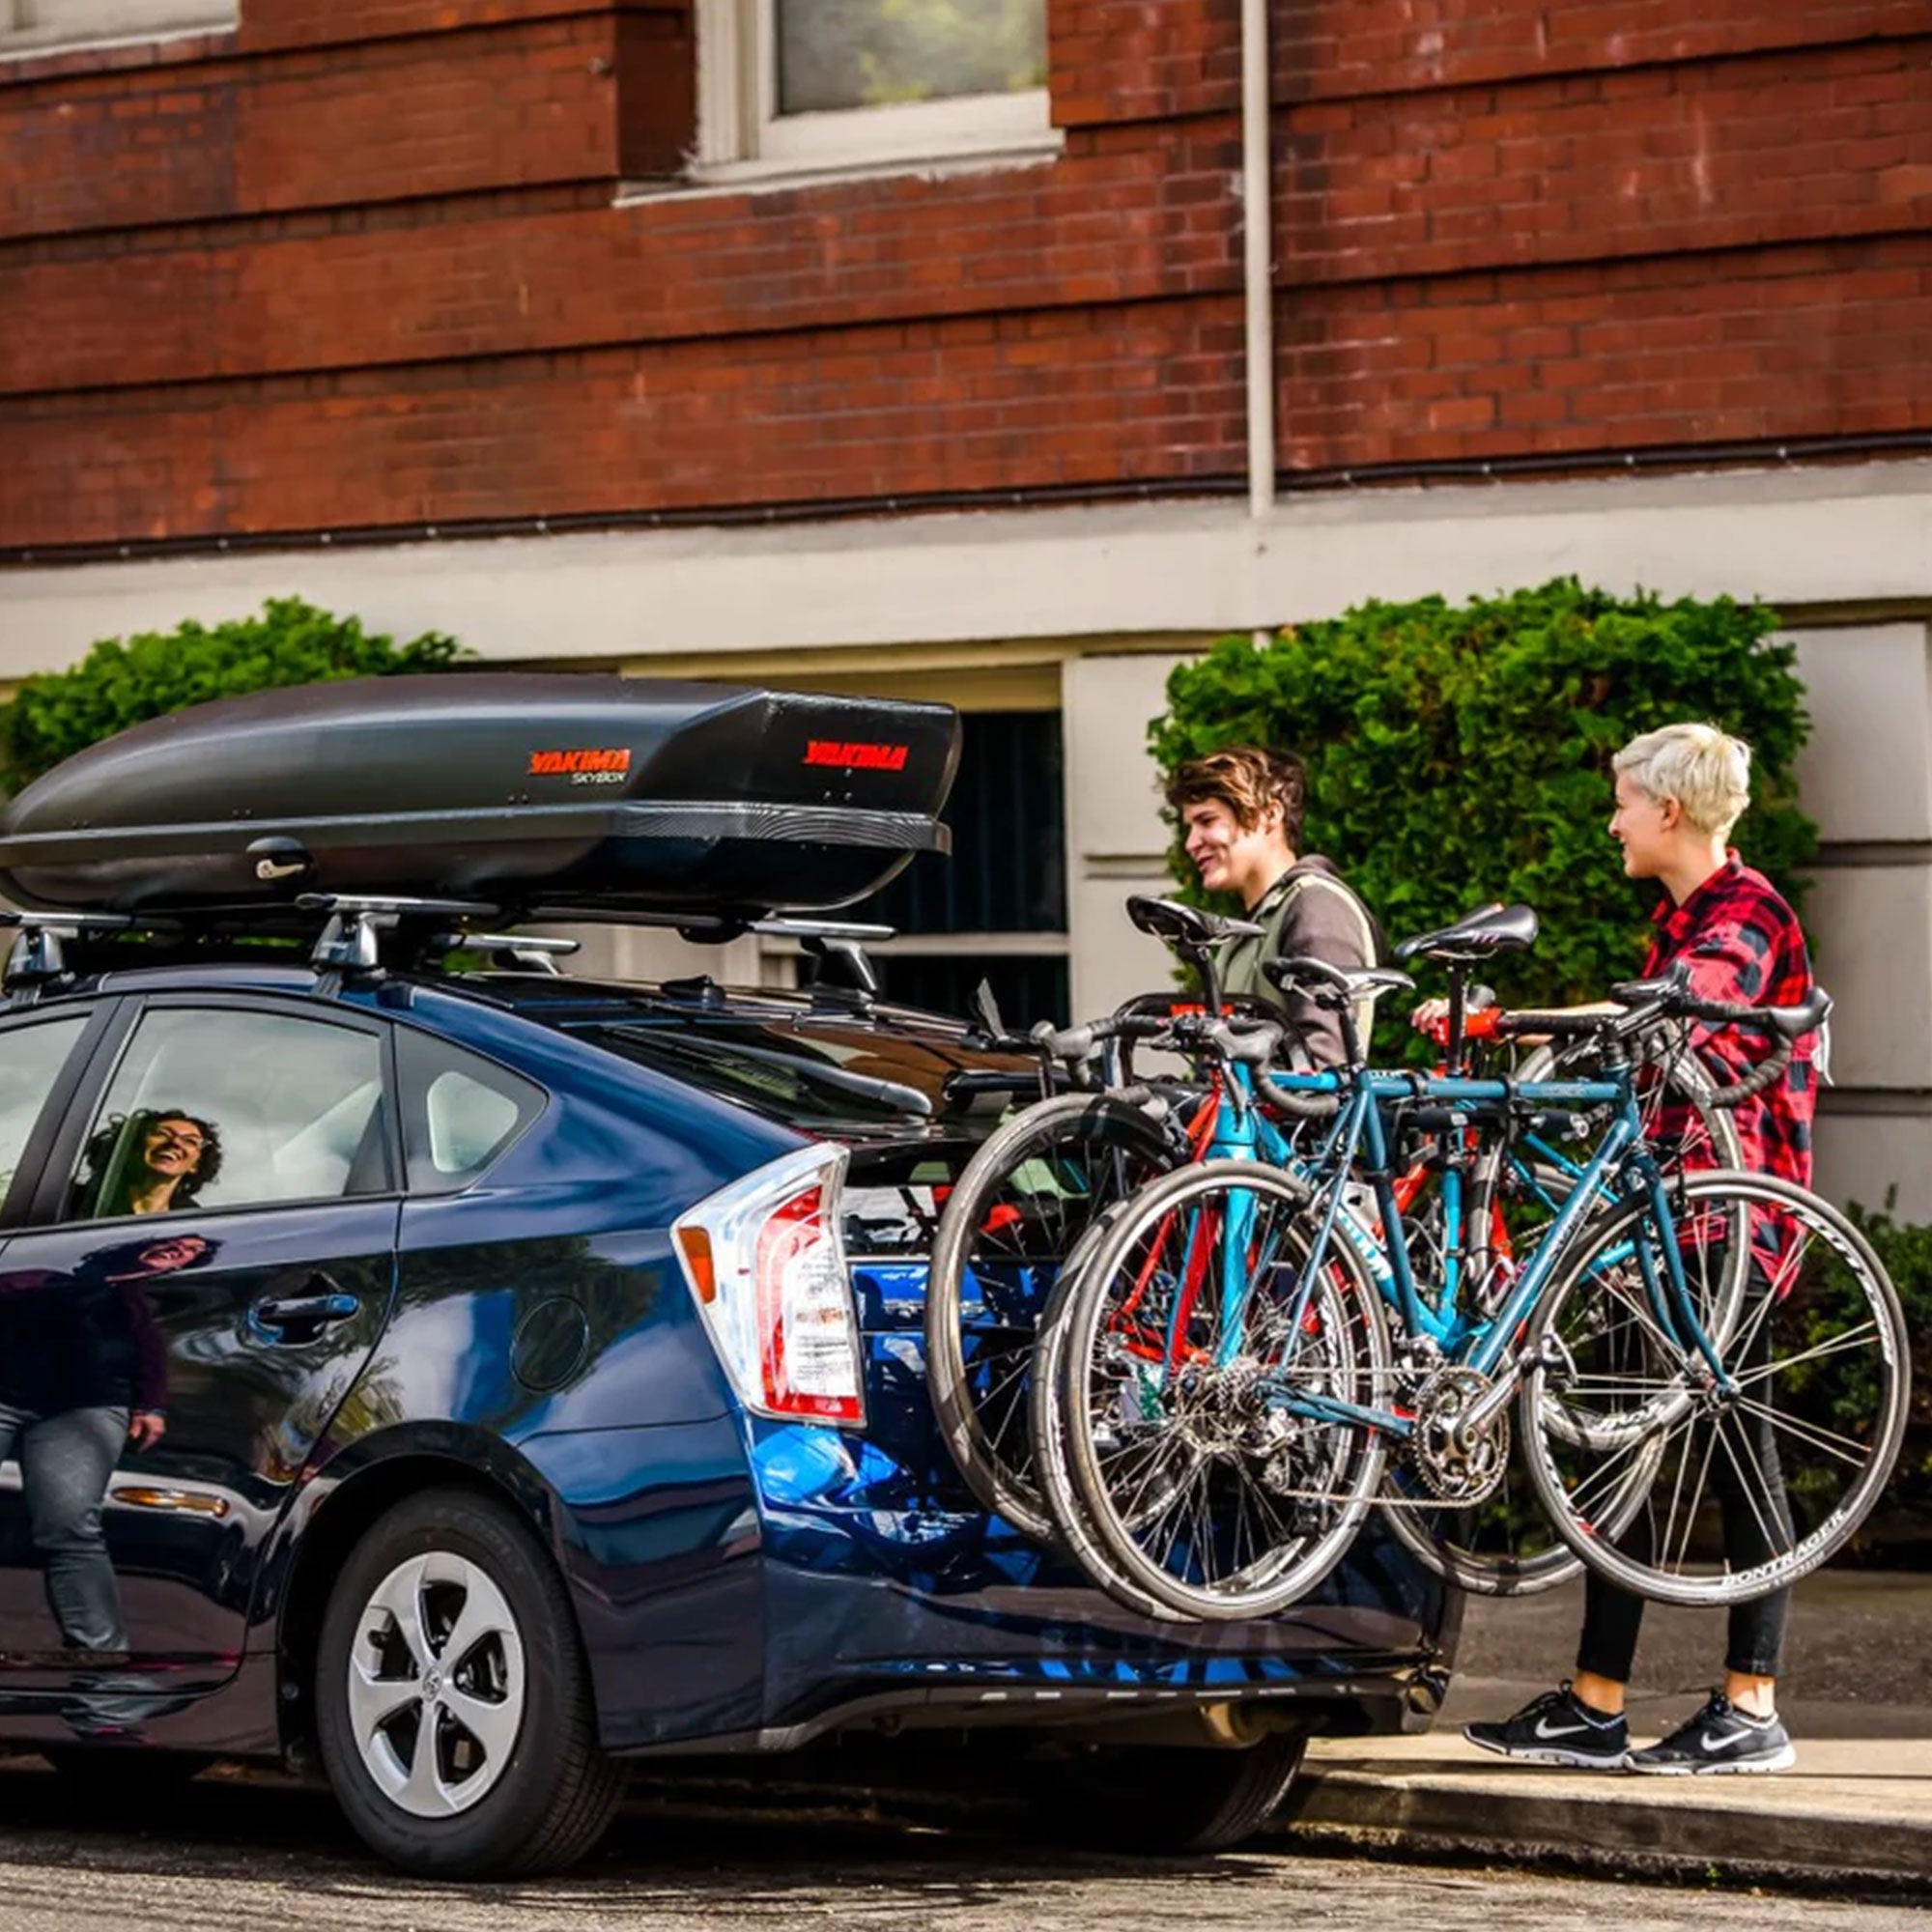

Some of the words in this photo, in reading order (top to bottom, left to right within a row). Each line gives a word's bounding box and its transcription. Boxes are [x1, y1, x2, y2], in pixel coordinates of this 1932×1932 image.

[531, 749, 630, 773] YAKIMA
[803, 740, 908, 770] YAKIMA
[572, 772, 626, 784] SKYBOX
[1720, 1508, 1845, 1586] BONTRAGER
